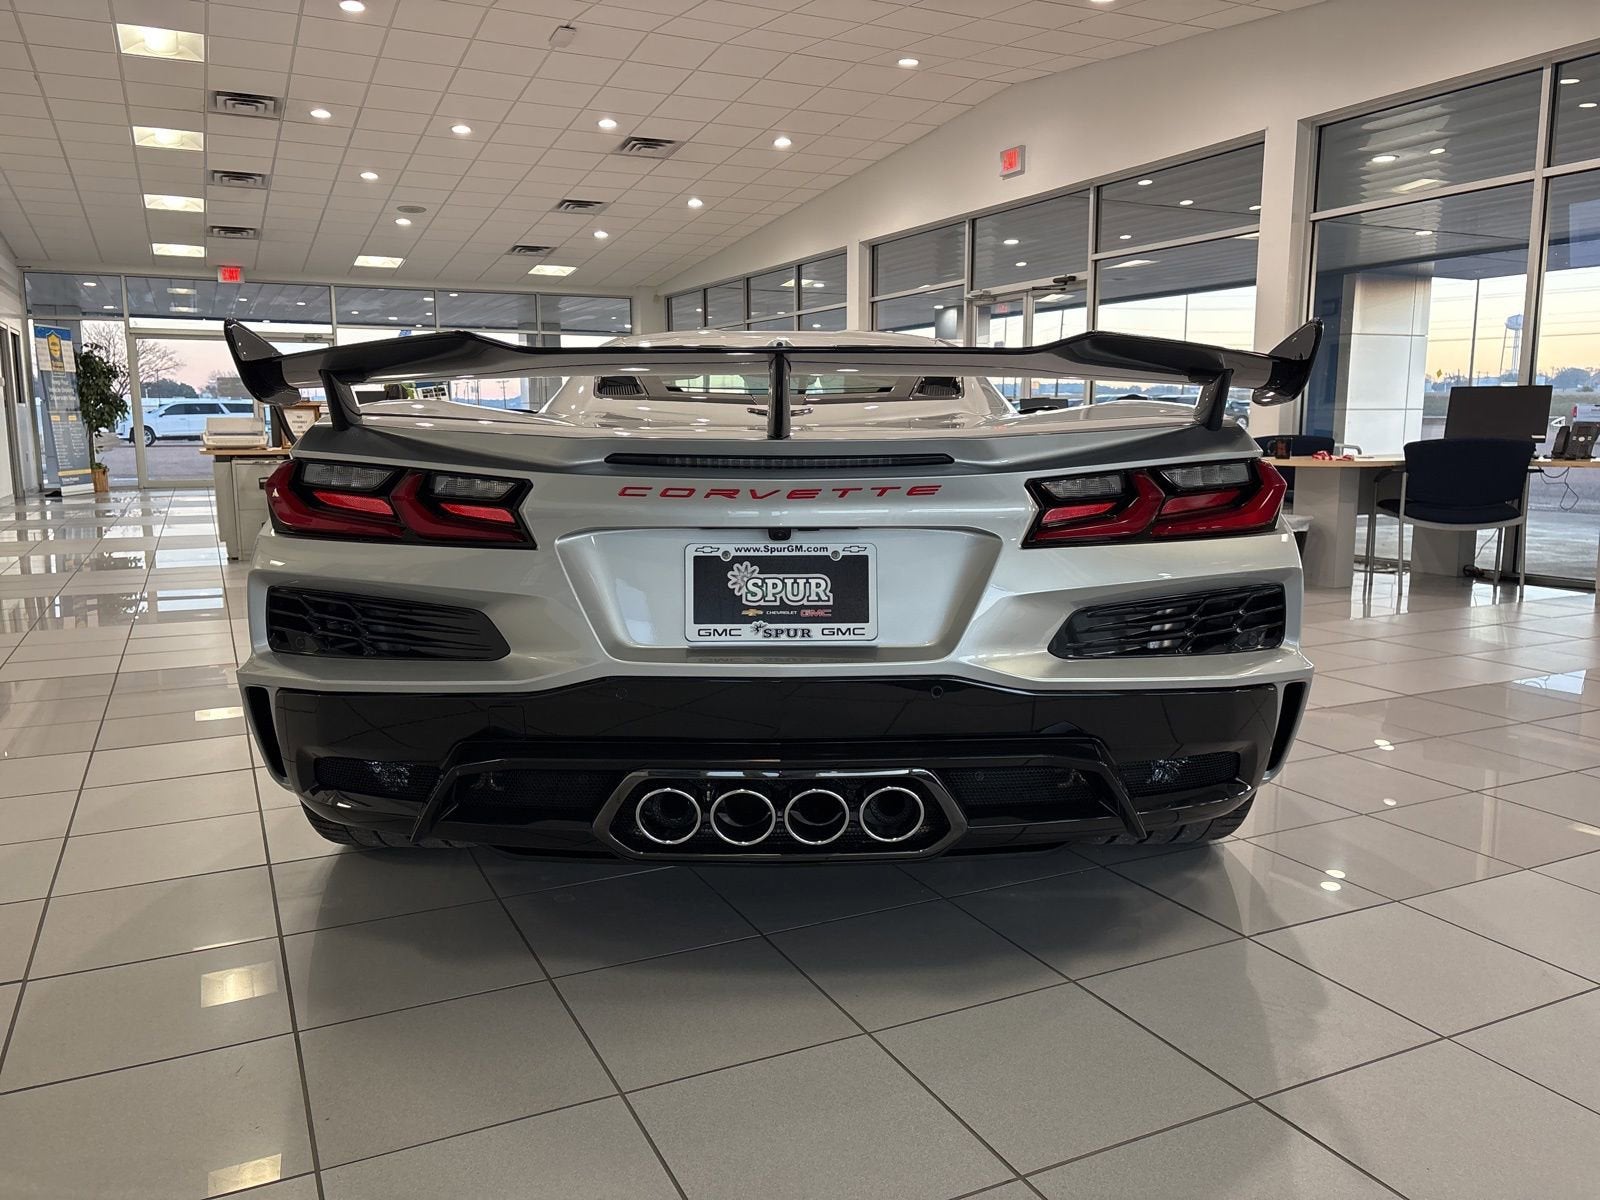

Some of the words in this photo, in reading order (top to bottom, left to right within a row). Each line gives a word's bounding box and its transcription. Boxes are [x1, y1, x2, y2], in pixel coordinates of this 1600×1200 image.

[617, 484, 943, 500] CORVETTE
[734, 544, 829, 555] www.SpurGM.com
[745, 576, 830, 604] SPUR
[800, 609, 832, 617] GMC
[697, 628, 742, 637] GMC
[763, 627, 812, 638] SPUR
[821, 627, 866, 636] GMC
